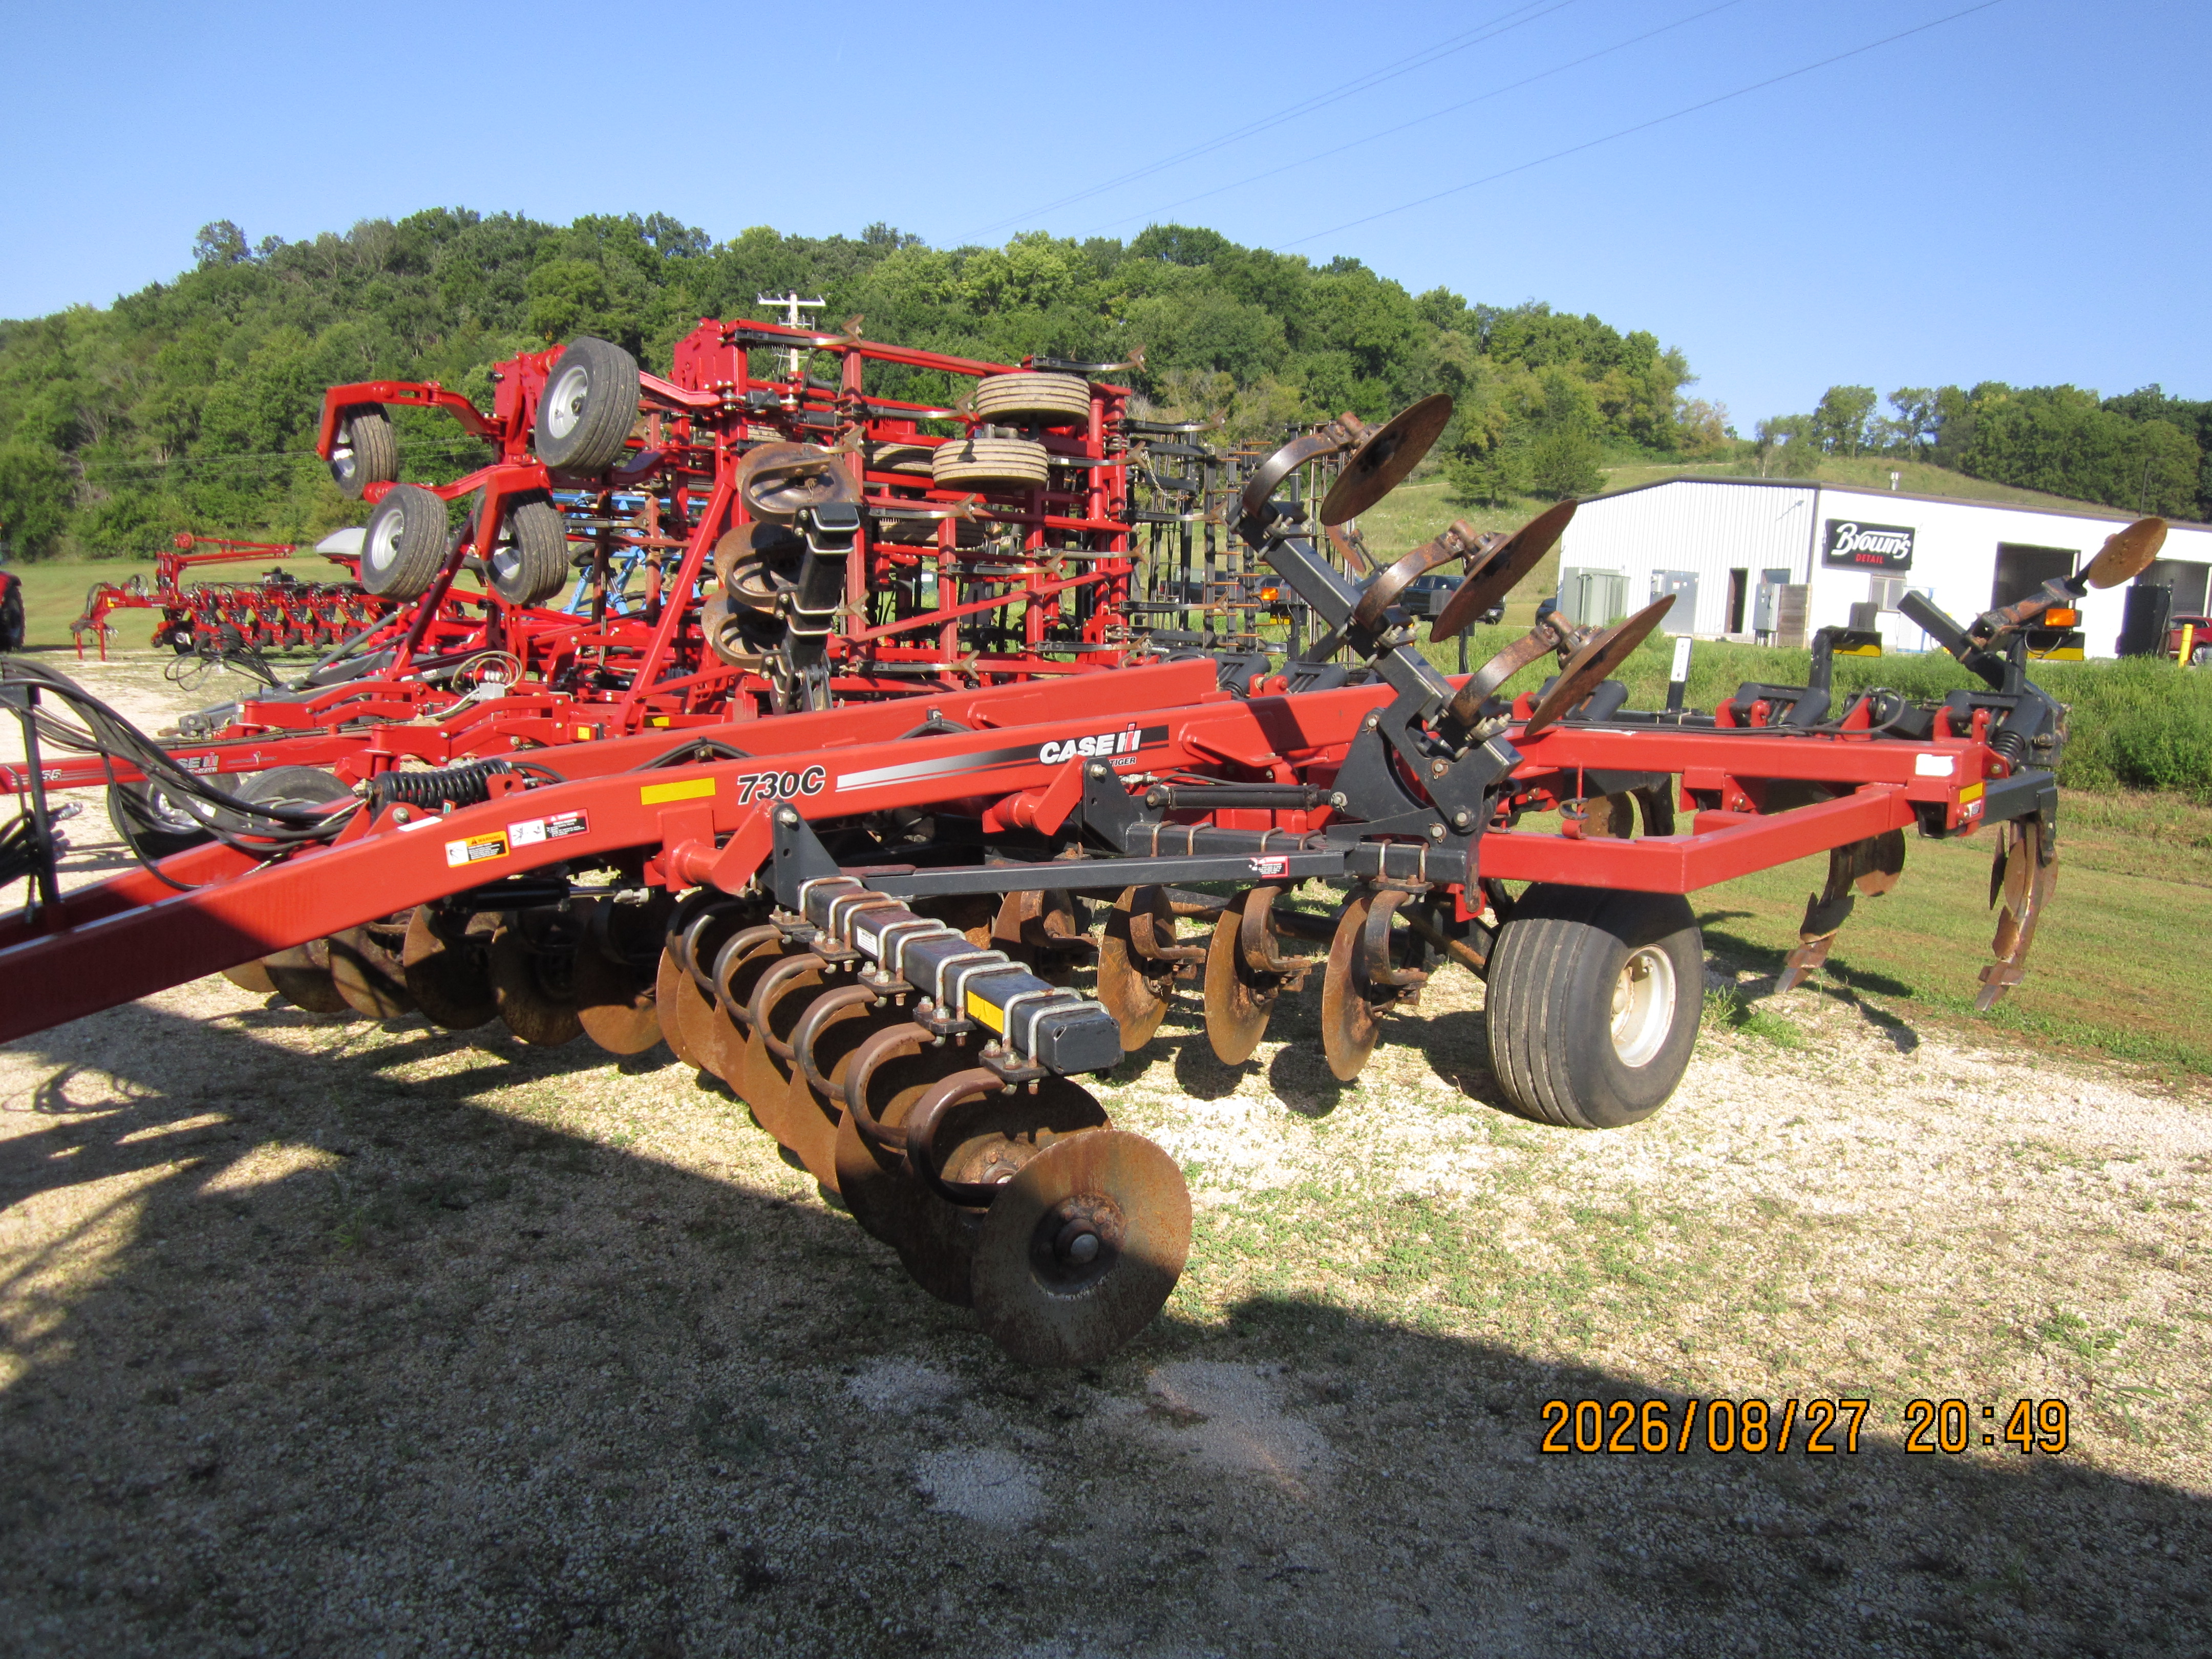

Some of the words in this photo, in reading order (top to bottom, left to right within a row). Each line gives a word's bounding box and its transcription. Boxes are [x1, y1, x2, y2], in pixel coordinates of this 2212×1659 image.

[1831, 523, 1911, 559] Brown's
[1856, 554, 1884, 564] DETAIL
[1039, 733, 1115, 764] CASE
[41, 769, 62, 781] 55
[737, 765, 825, 805] 730C
[478, 834, 501, 843] WARNING
